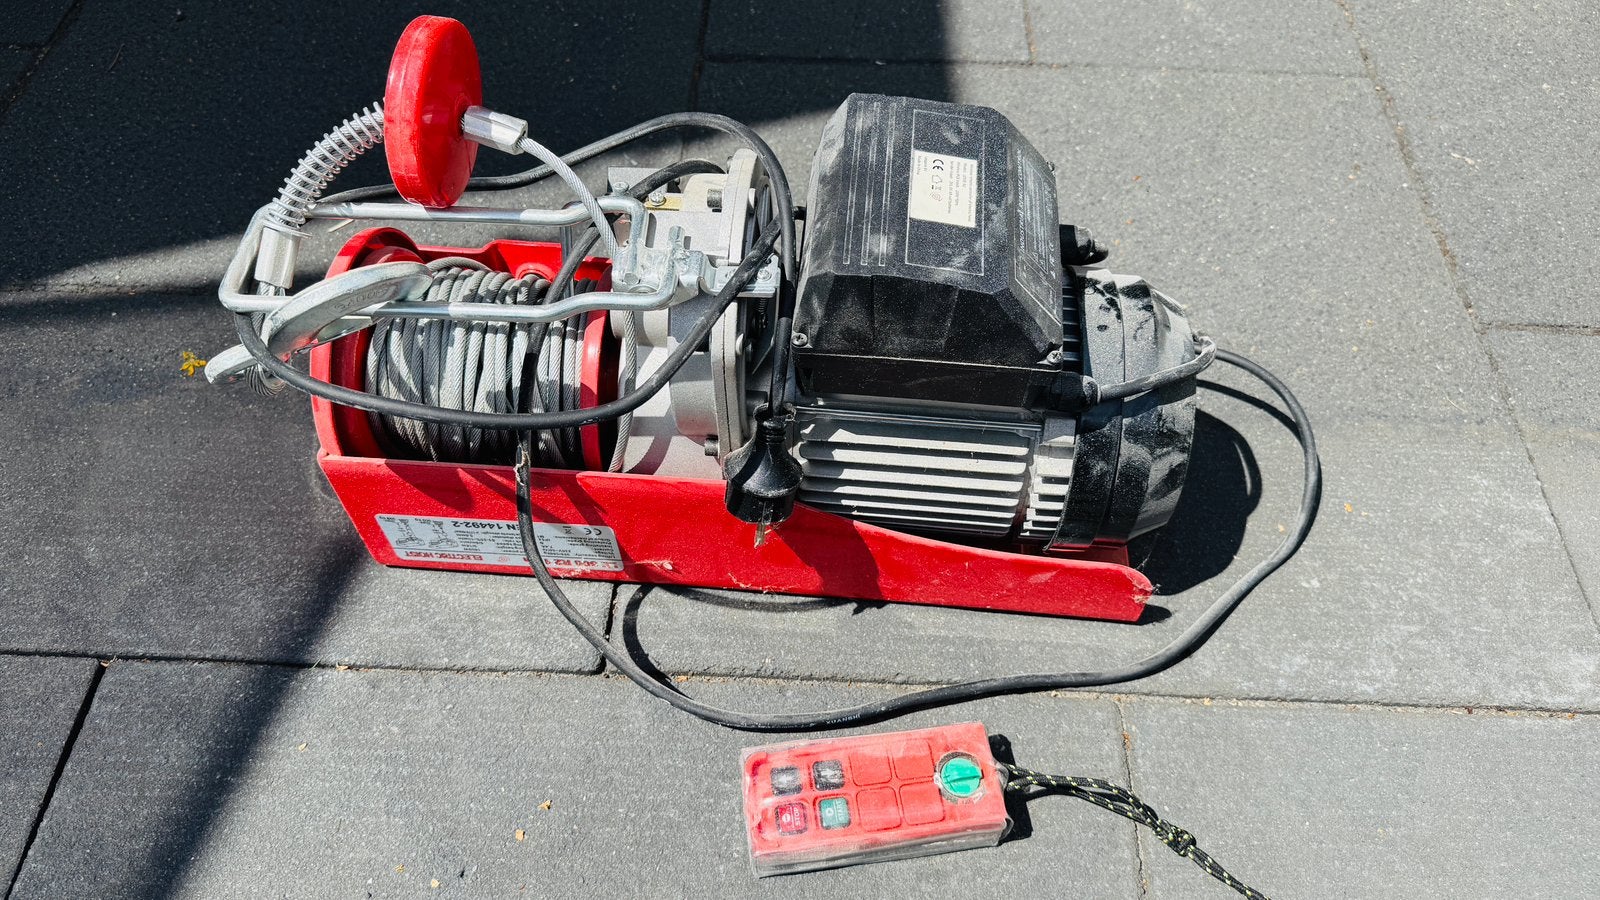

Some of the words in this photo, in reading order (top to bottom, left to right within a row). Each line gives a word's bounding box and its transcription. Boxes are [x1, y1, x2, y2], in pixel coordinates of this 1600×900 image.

[932, 159, 944, 171] CE
[451, 520, 503, 530] 14492-2
[584, 528, 602, 536] CE
[405, 550, 434, 558] HOIST
[435, 553, 483, 561] ELECTRIC
[836, 799, 846, 822] START
[793, 806, 801, 827] STOP
